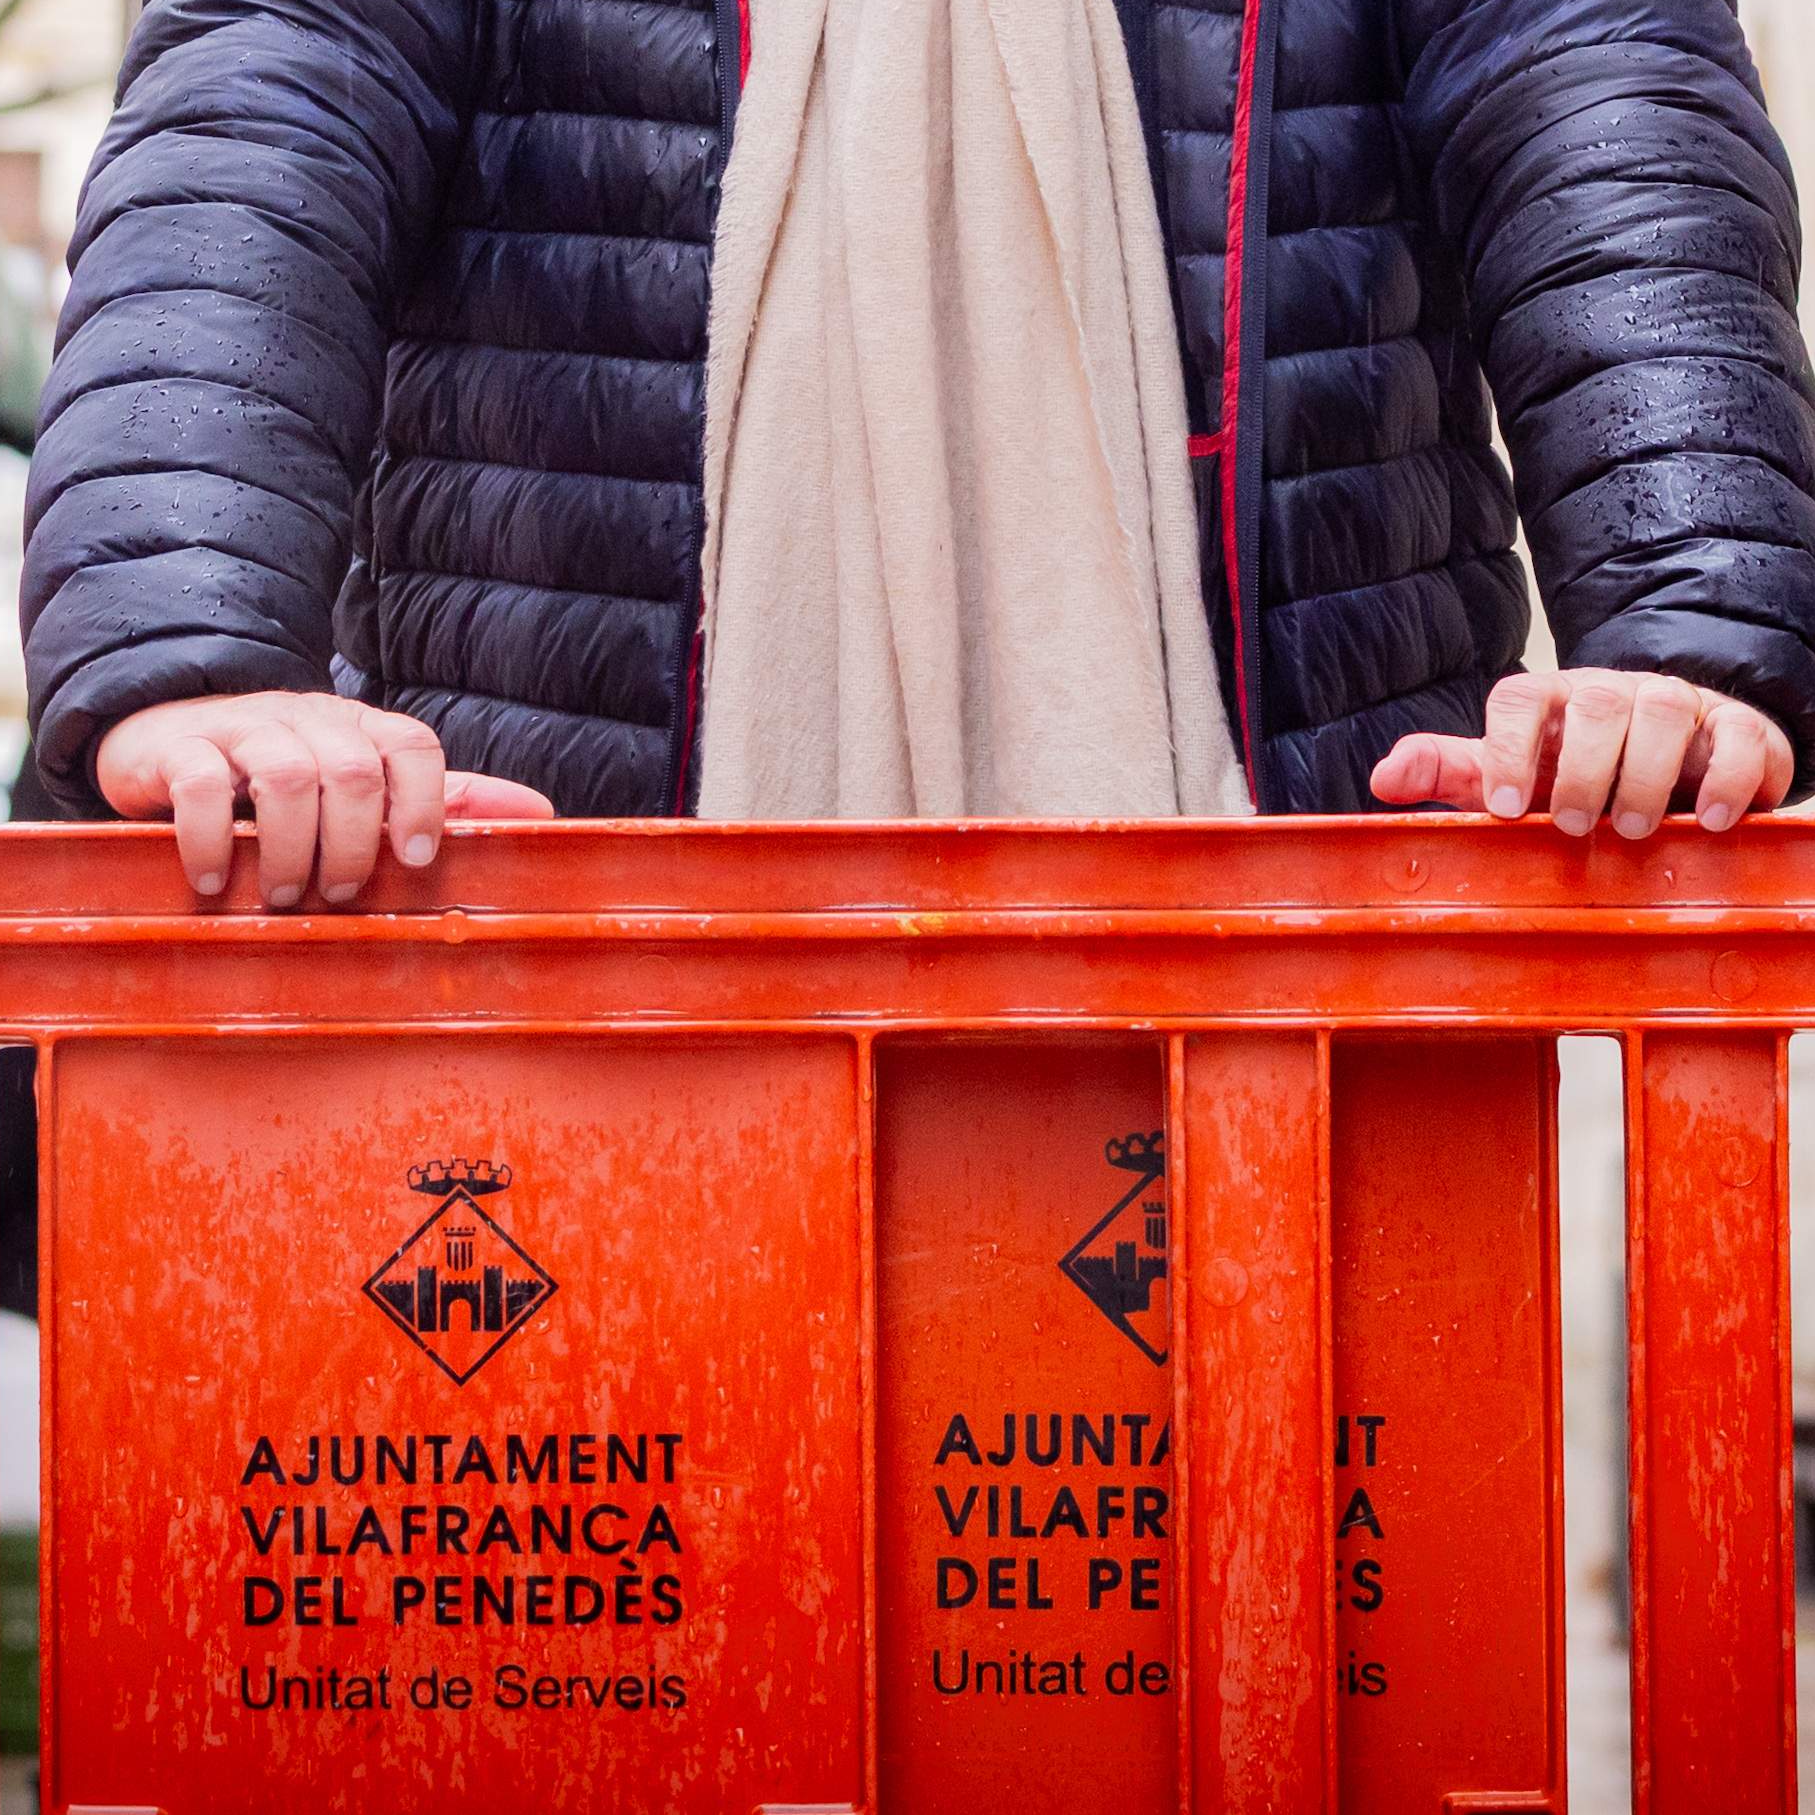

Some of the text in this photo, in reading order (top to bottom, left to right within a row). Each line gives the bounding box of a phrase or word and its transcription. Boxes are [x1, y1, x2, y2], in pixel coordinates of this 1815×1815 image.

[239, 1433, 683, 1486] AJUNTAMENT
[933, 1413, 1386, 1467] AJUNTT
[239, 1503, 682, 1556] VILAFRANCA
[934, 1485, 1385, 1539] VILAFRA
[242, 1558, 683, 1627] DEL PENEDÈS
[935, 1557, 1054, 1610] DEL
[240, 1664, 688, 1711] Unitat de Serveis
[932, 1649, 1169, 1696] Unitat de
